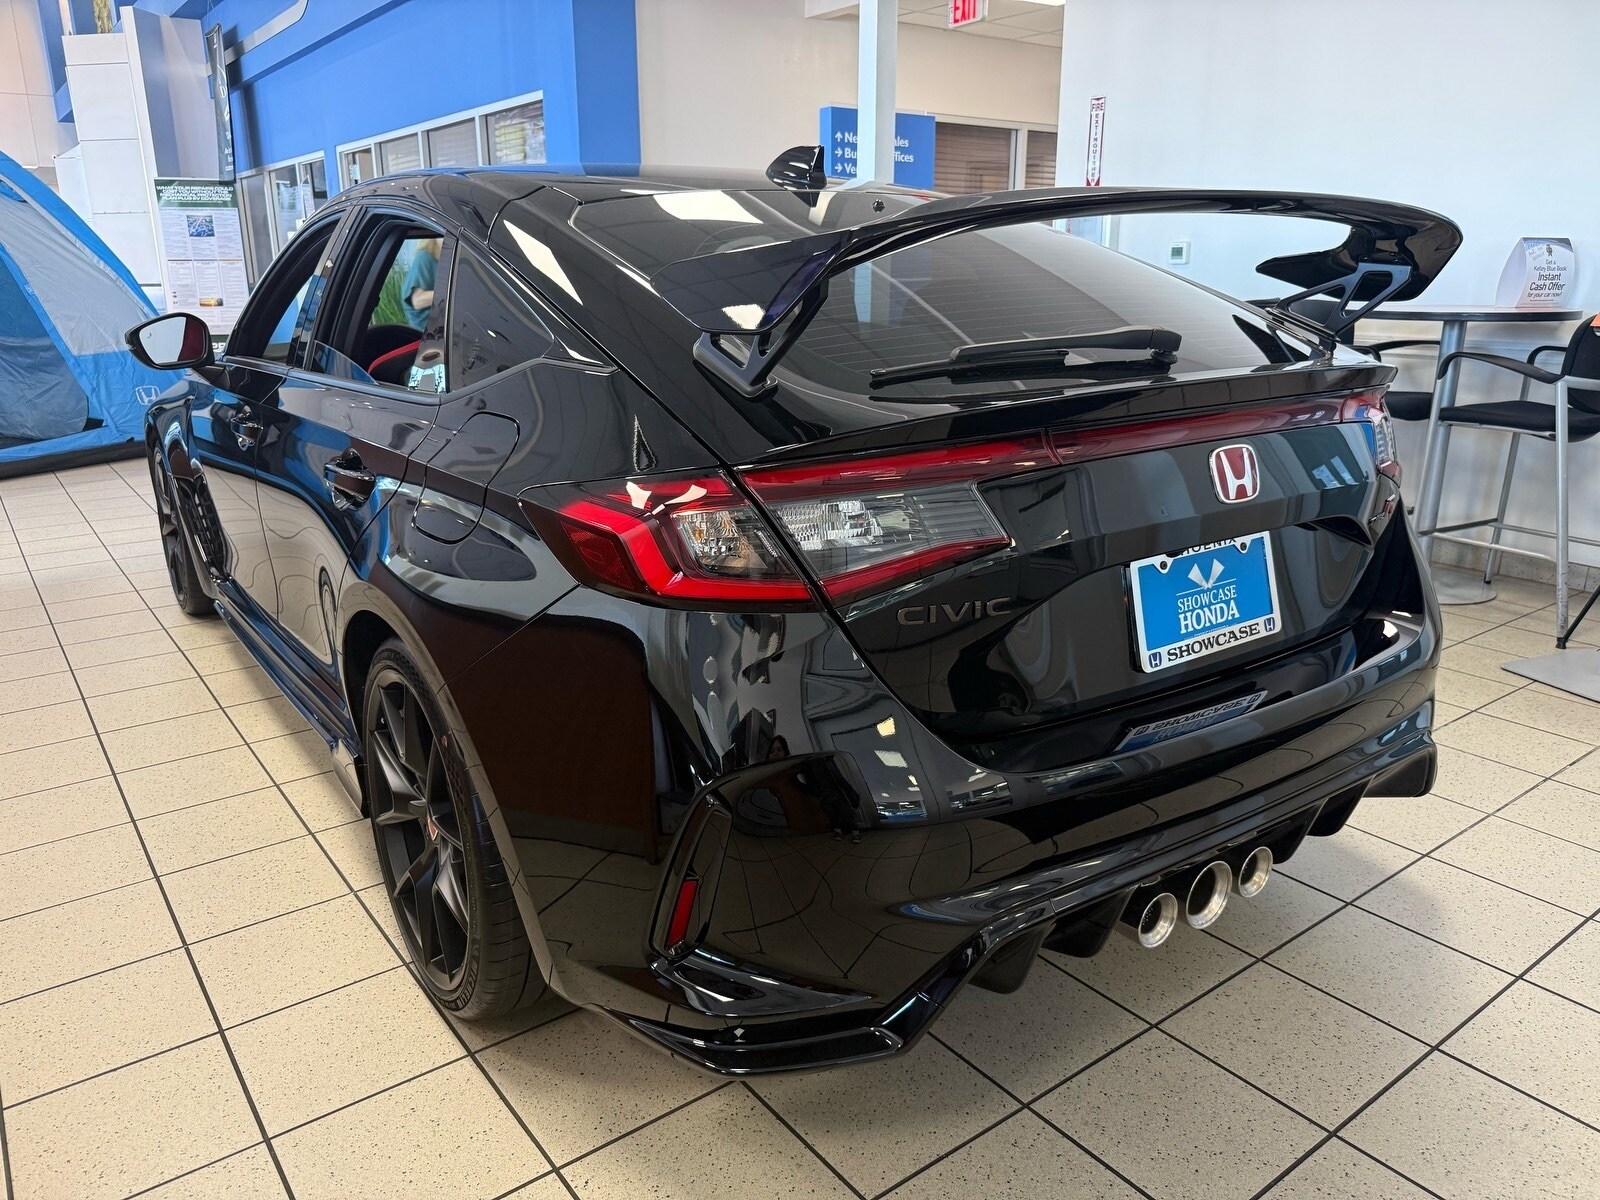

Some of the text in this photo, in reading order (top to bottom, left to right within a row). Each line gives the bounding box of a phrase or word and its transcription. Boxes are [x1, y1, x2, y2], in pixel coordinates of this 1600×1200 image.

[1091, 102, 1104, 112] FIRE
[893, 136, 909, 148] ales
[1091, 113, 1100, 183] EXTINGUISHER
[1530, 282, 1566, 290] Cash Offer
[1538, 272, 1562, 281] Instant
[897, 597, 1011, 626] CIVIC
[1177, 584, 1237, 613] SHOWCASE
[1179, 599, 1240, 635] HONDA
[1167, 622, 1261, 663] SHOWCASE
